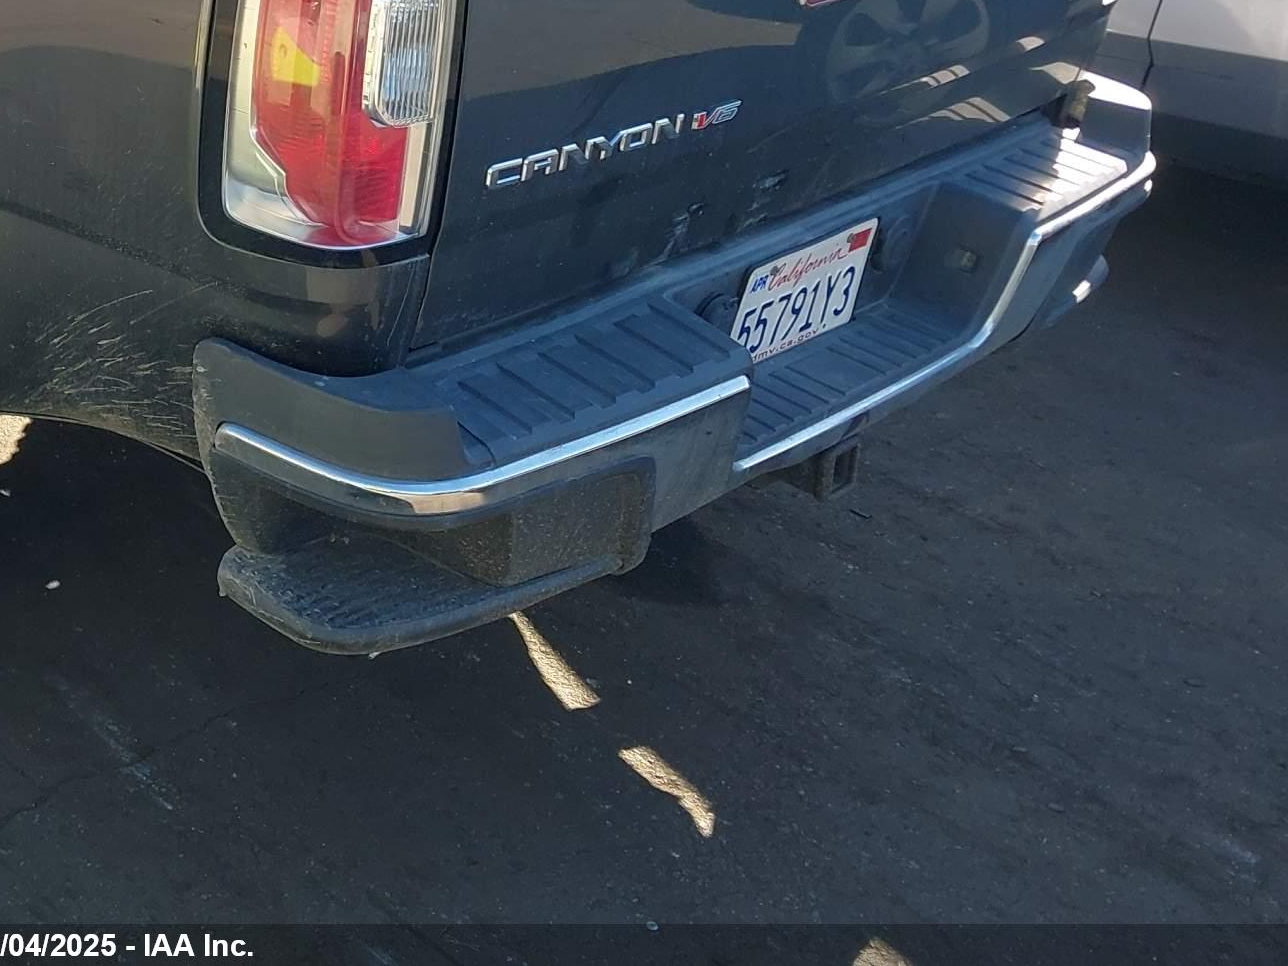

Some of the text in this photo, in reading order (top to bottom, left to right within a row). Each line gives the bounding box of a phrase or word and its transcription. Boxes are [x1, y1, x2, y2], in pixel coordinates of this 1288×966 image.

[485, 100, 742, 189] CANYON V6
[737, 266, 856, 353] 55791Y3
[749, 246, 848, 294] APR California
